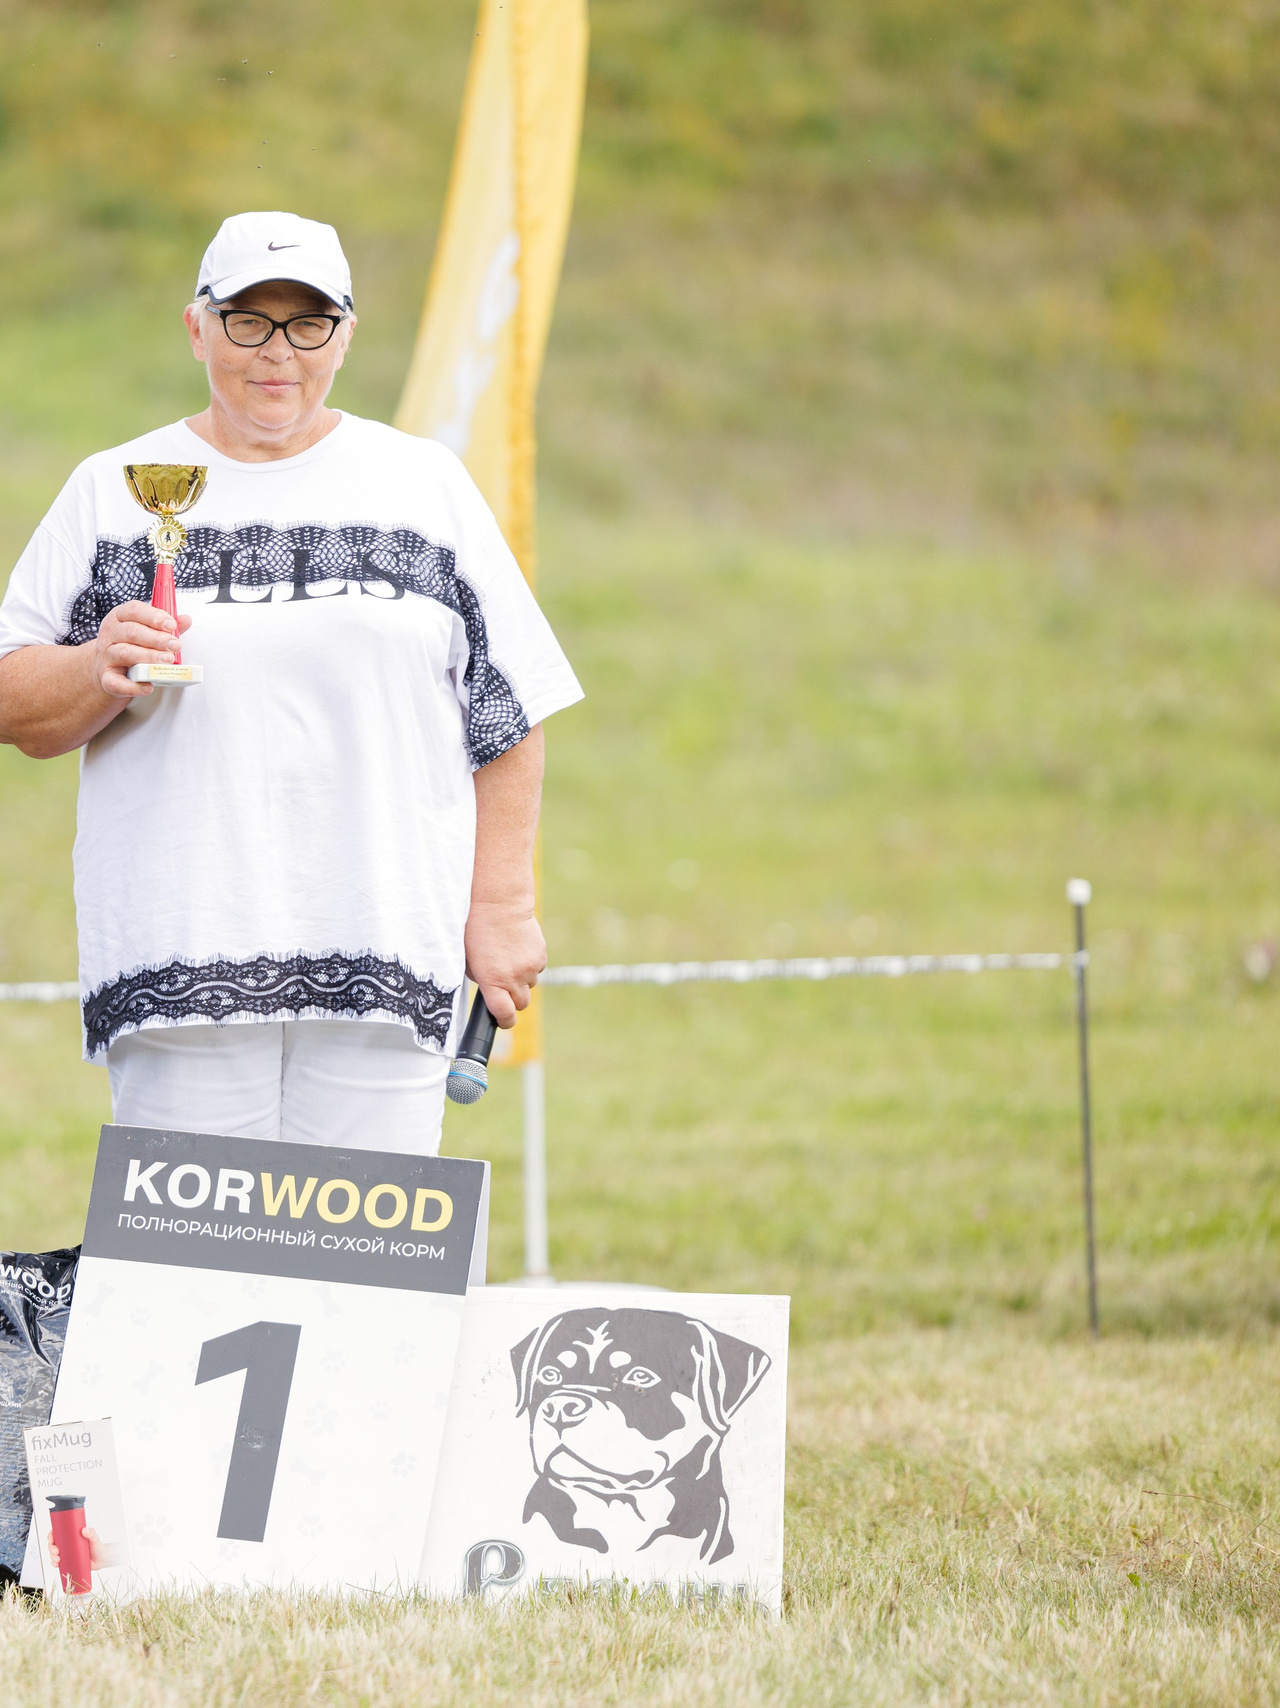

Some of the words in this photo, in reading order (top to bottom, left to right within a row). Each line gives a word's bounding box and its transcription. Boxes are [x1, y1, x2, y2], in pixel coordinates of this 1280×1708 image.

[123, 1159, 454, 1232] KORWOOD
[117, 1213, 317, 1248] ПОЛНОРАЦИОННЫЙ
[320, 1233, 385, 1255] СУХОЙ
[389, 1241, 446, 1261] КОРМ
[31, 1431, 92, 1451] fixMug
[194, 1320, 302, 1543] 1
[34, 1453, 58, 1464] FALL
[36, 1459, 103, 1476] PROTECTION
[37, 1477, 63, 1489] MUG
